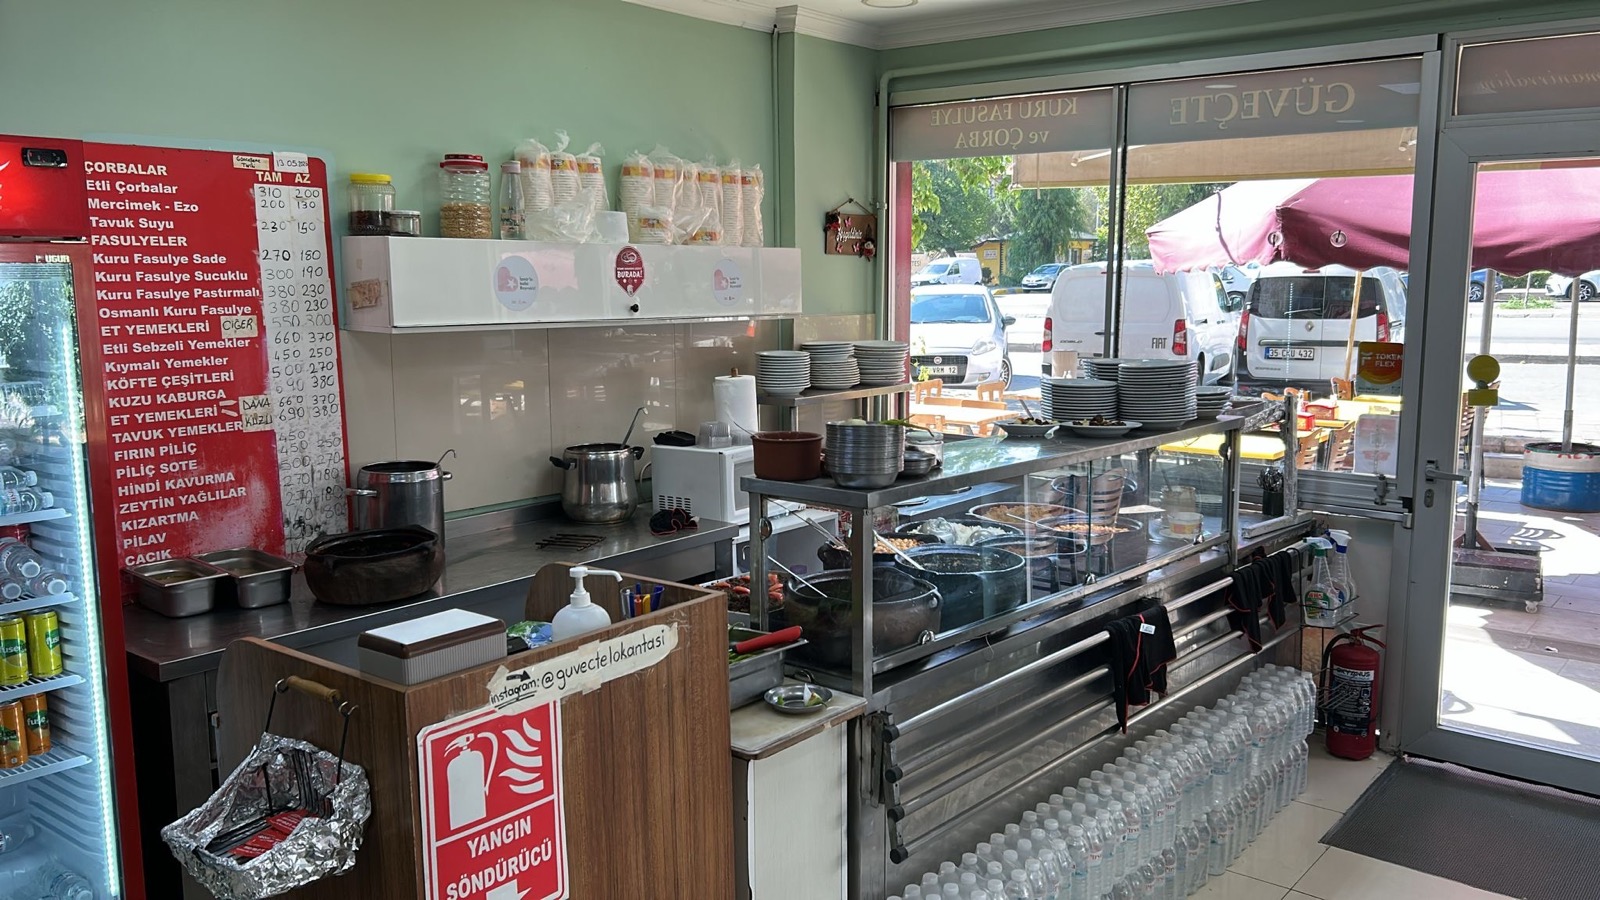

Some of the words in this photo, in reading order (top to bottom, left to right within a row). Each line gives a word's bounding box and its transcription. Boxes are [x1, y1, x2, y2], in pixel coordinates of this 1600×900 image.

[84, 161, 167, 176] ÇORBALAR
[255, 171, 282, 183] TAM
[294, 174, 311, 184] AZ
[86, 180, 111, 191] Etli
[115, 181, 178, 194] Çorbalar
[258, 187, 282, 198] 310
[295, 188, 320, 198] 200
[87, 198, 161, 211] Mercimek
[174, 201, 199, 212] Ezo
[260, 200, 285, 209] 200
[297, 200, 316, 209] 130
[89, 216, 134, 228] Tavuk
[138, 218, 174, 231] Suyu
[262, 221, 286, 232] 230
[297, 222, 316, 234] 150
[91, 235, 188, 247] FASULYELER
[93, 253, 129, 264] Kuru
[134, 253, 188, 266] Fasulye
[192, 254, 227, 264] Sade
[262, 249, 290, 262] 270
[300, 250, 321, 261] 180
[95, 271, 131, 282] Kuru
[136, 270, 190, 284] Fasulye
[194, 270, 248, 282] Sucuklu
[266, 268, 294, 280] 300
[302, 266, 323, 278] 190
[617, 270, 643, 278] BURADA!
[96, 290, 132, 300] Kuru
[136, 288, 190, 301] Fasulye
[194, 288, 260, 298] Pastırmalı
[268, 285, 296, 298] 380
[302, 284, 324, 298] 230
[99, 307, 159, 318] Osmanlı
[163, 306, 196, 316] Kuru
[200, 305, 252, 318] Fasulye
[270, 300, 300, 314] 380
[304, 298, 328, 312] 230
[101, 325, 120, 336] ET
[125, 320, 210, 336] YEMEKLERİ
[274, 332, 300, 344] 660
[308, 332, 334, 343] 370
[1152, 338, 1168, 348] FIAT
[102, 344, 128, 355] Etli
[132, 341, 184, 354] Sebzeli
[188, 339, 250, 350] Yemekler
[274, 348, 300, 361] 450
[310, 347, 333, 358] 250
[1270, 349, 1278, 357] 35
[1298, 350, 1313, 358] 432
[105, 360, 160, 374] Kıymalı
[164, 356, 229, 369] Yemekler
[272, 364, 302, 378] 500
[310, 362, 334, 374] 270
[948, 366, 956, 374] 12
[1374, 360, 1395, 368] FLEX
[106, 377, 158, 391] KÖFTE
[162, 370, 234, 389] ÇEŞİTLERİ
[312, 375, 334, 388] 380
[109, 395, 152, 408] KUZU
[156, 389, 227, 405] KABURGA
[242, 398, 271, 410] DANA
[279, 396, 304, 408] 660
[312, 394, 336, 405] 370
[110, 415, 132, 426] ET
[134, 404, 218, 424] YEMEKLERİ
[279, 407, 305, 421] 690
[312, 404, 338, 418] 380
[112, 428, 164, 444] TAVUK
[317, 437, 341, 448] 250
[114, 447, 156, 462] FIRIN
[159, 442, 197, 456] PİLİÇ
[116, 464, 156, 480] PİLİÇ
[160, 460, 198, 474] SOTE
[118, 481, 161, 497] HİNDİ
[165, 472, 236, 490] KAVURMA
[119, 496, 175, 515] ZEYTİN
[178, 486, 248, 506] YAĞLILAR
[122, 510, 200, 532] KIZARTMA
[123, 532, 167, 550] PİLAV
[124, 549, 172, 567] CACIK
[466, 815, 532, 859] YANGIN
[446, 837, 552, 900] SÖNDÜRÜCÜ
